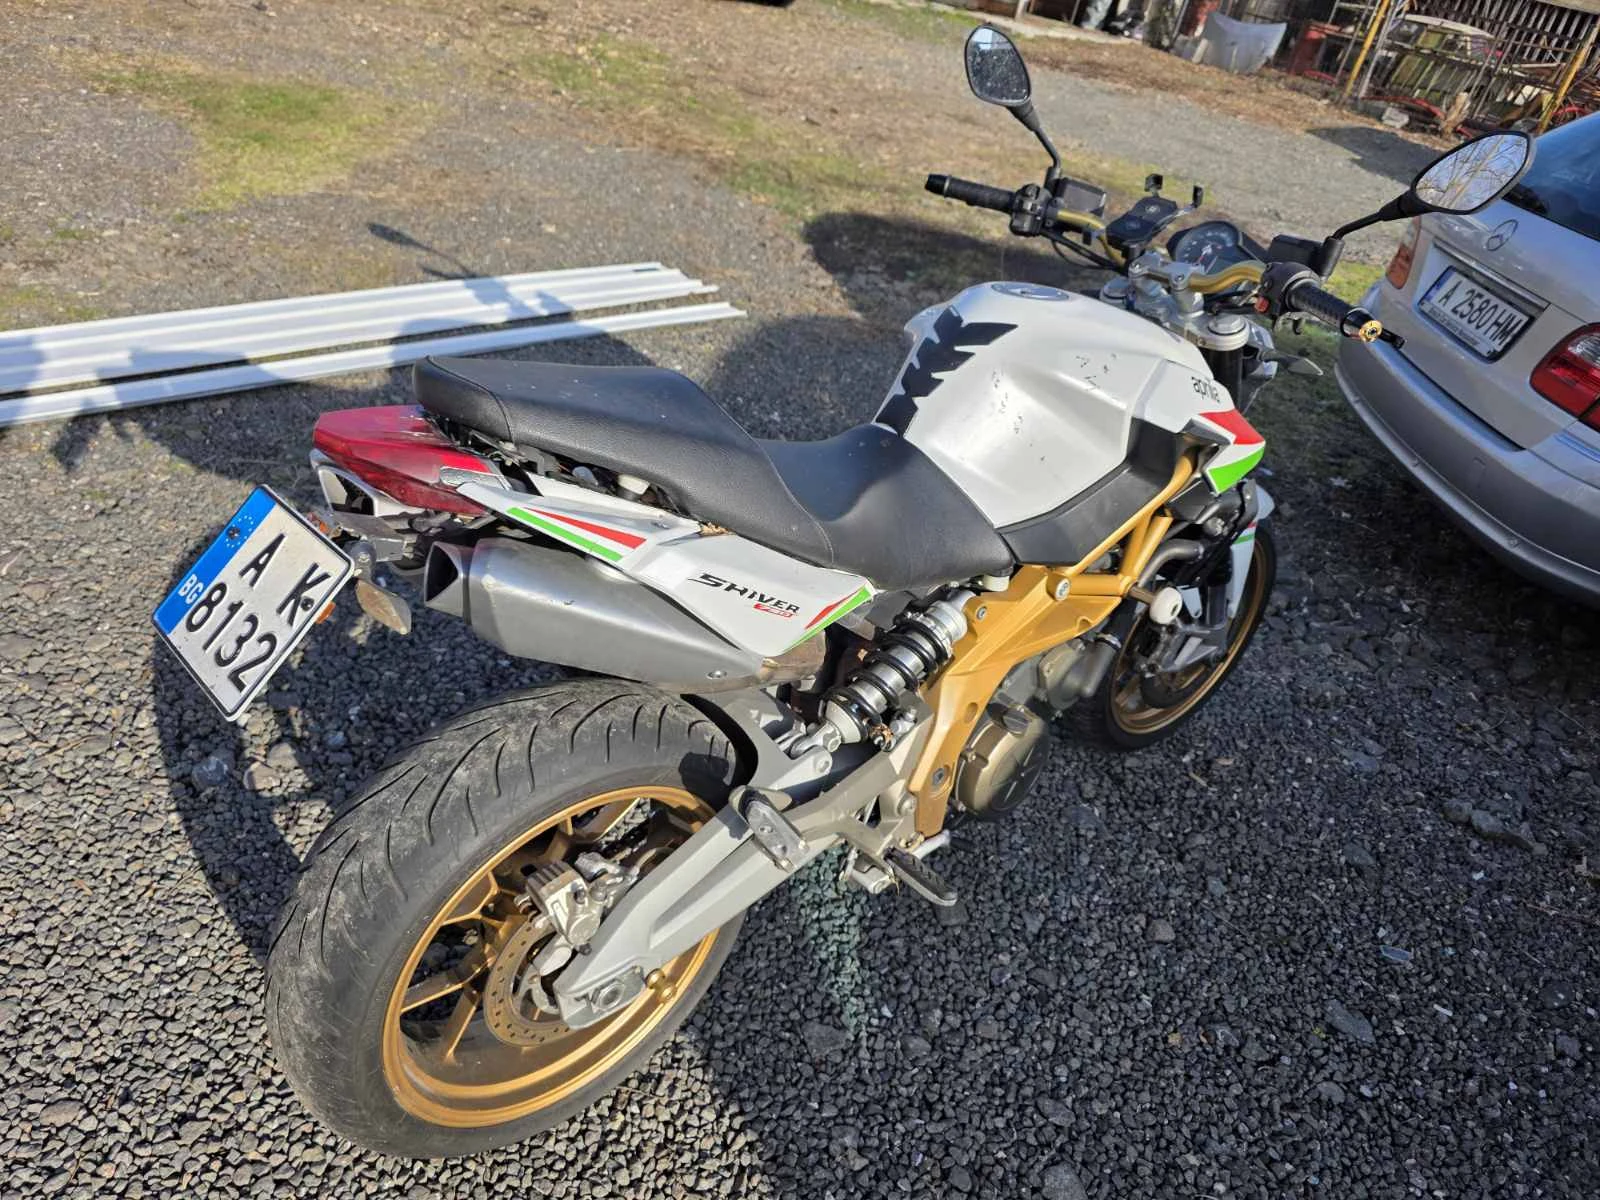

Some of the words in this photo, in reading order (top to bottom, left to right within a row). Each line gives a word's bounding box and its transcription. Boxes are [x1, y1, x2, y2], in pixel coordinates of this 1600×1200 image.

[1438, 280, 1462, 306] A
[1451, 288, 1498, 330] 2580
[1483, 309, 1523, 346] HM
[178, 574, 204, 604] BG
[239, 532, 285, 588] A
[276, 563, 332, 628] K
[687, 573, 800, 613] SHIVER
[185, 582, 278, 694] 8132
